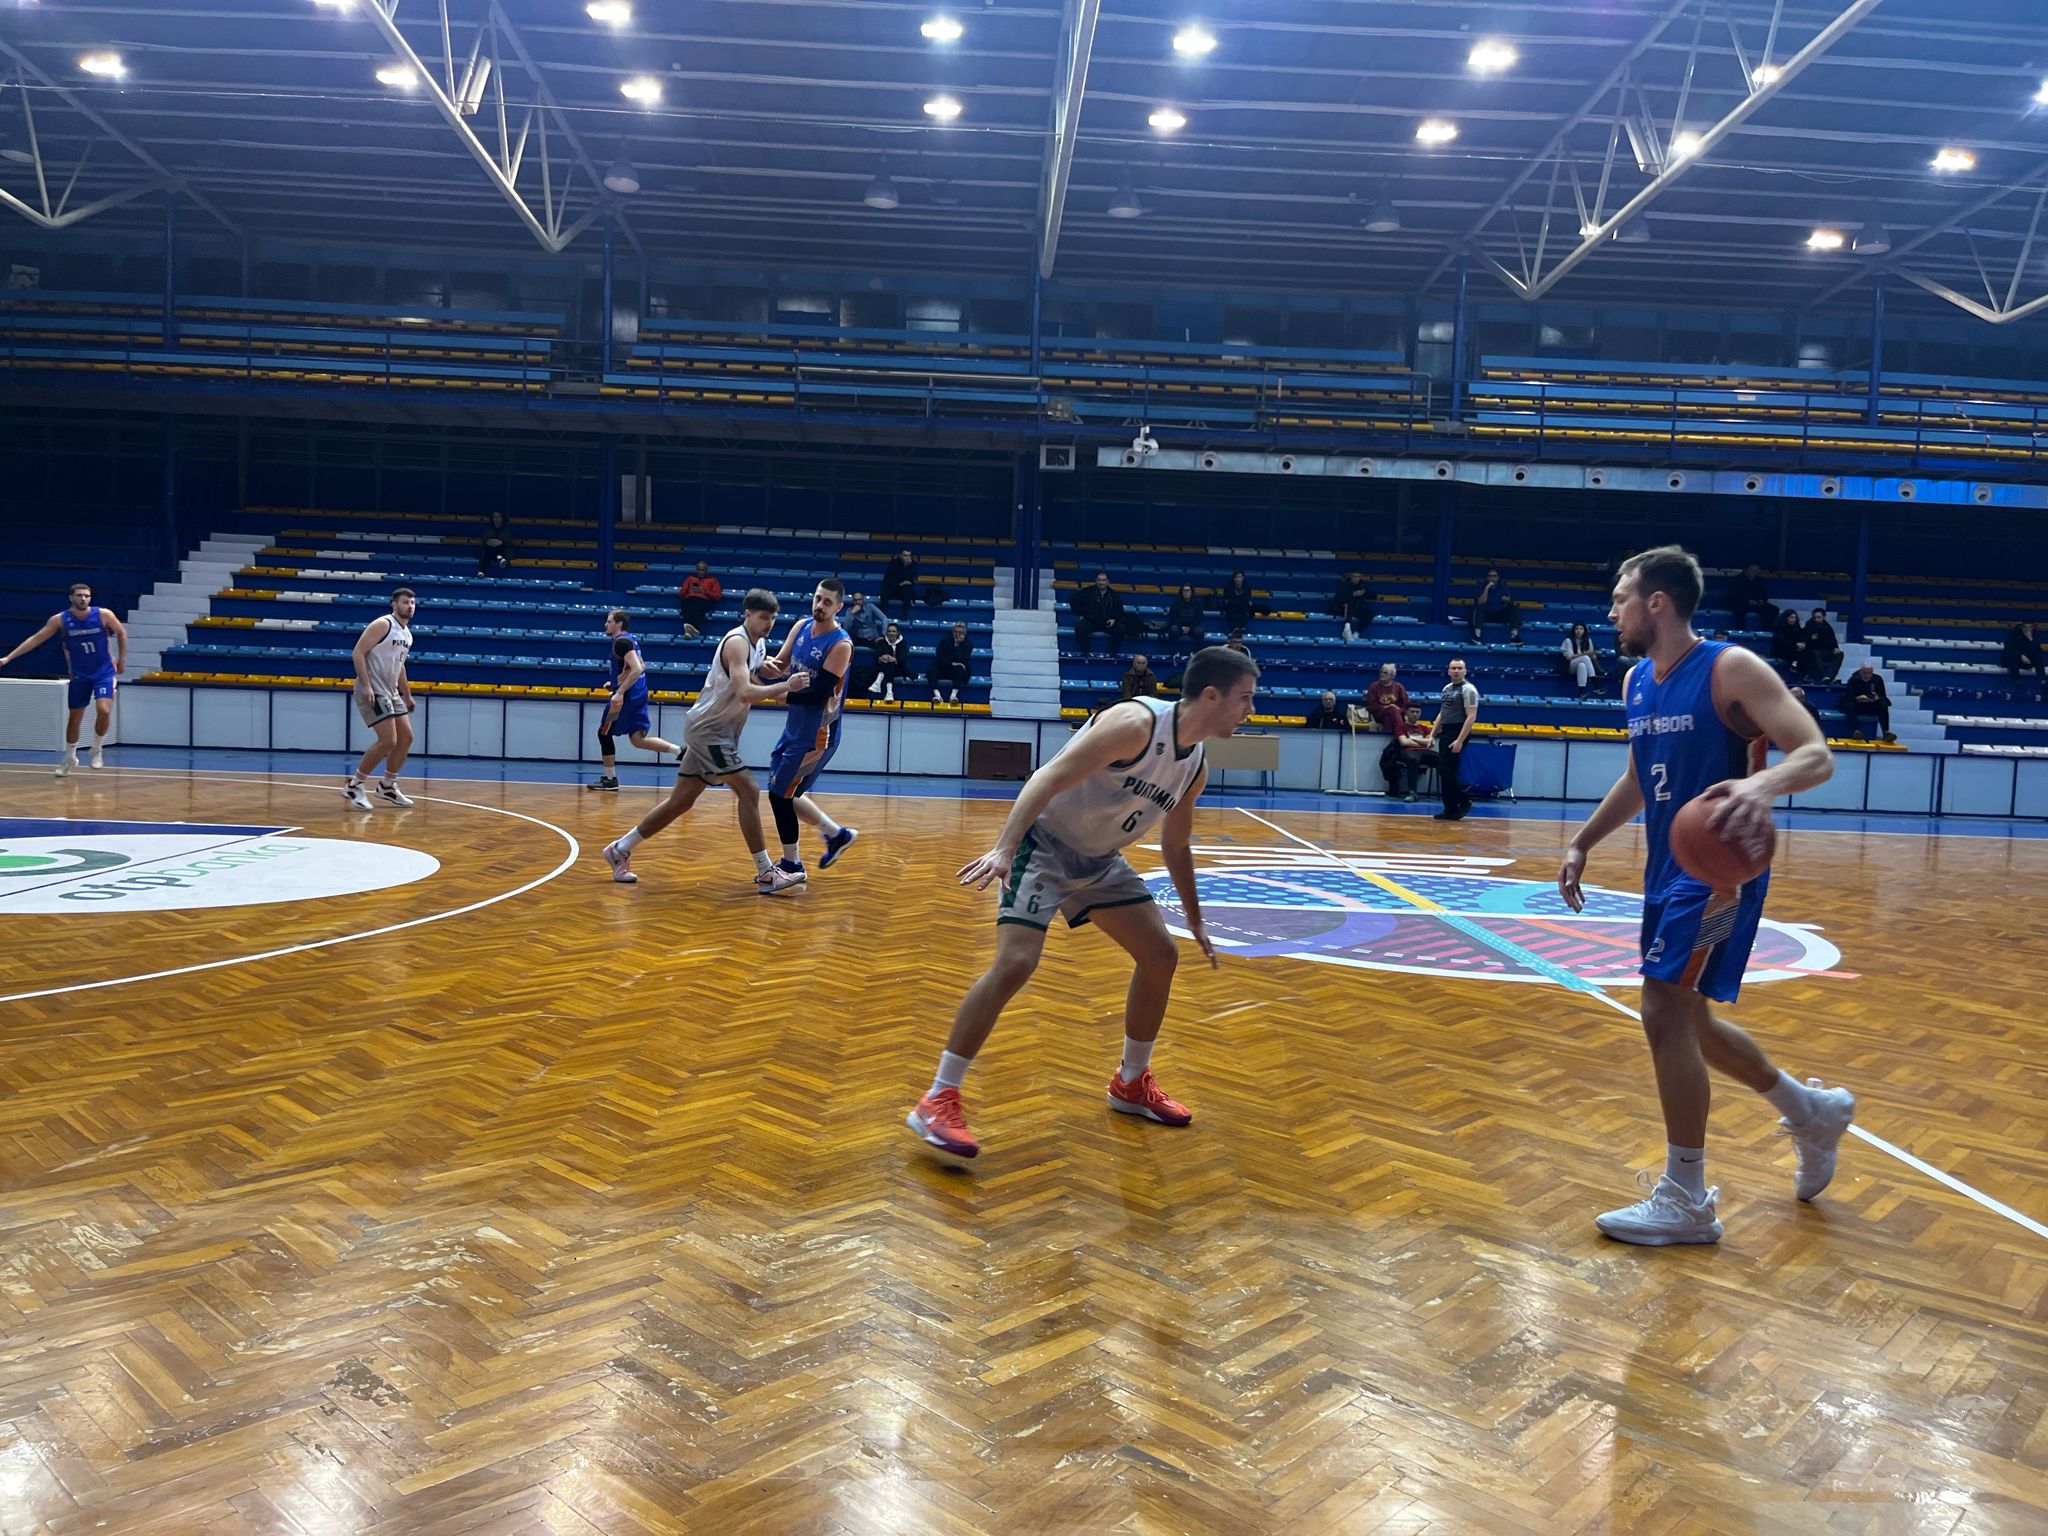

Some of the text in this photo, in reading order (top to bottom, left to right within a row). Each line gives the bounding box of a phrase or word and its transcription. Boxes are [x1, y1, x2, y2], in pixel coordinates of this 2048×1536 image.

[81, 641, 96, 654] 11
[810, 646, 823, 661] 22
[1650, 763, 1671, 801] 2
[1121, 810, 1143, 833] 6
[1027, 894, 1041, 914] 6
[1645, 937, 1665, 963] 2
